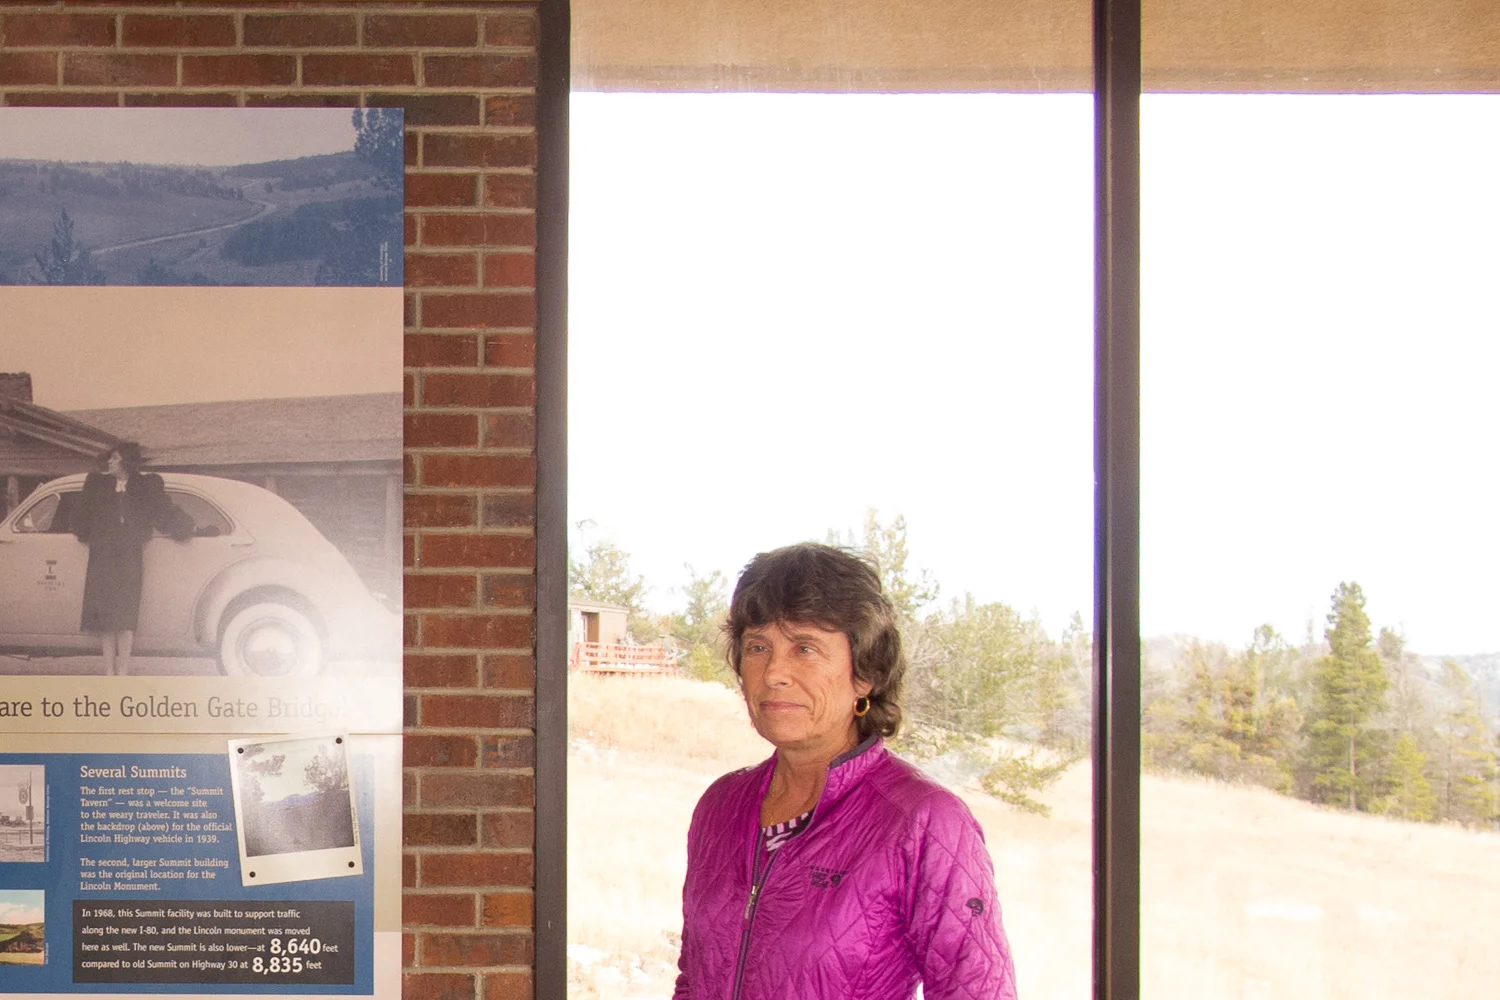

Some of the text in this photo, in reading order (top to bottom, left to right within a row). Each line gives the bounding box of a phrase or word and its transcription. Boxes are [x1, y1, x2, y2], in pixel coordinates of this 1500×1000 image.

[41, 697, 64, 718] to
[73, 695, 111, 718] the
[120, 695, 198, 718] Golden
[208, 696, 258, 718] Gate
[80, 764, 188, 779] Several Summits
[80, 881, 162, 892] Lincoln Monument.
[82, 908, 92, 918] In
[117, 908, 134, 918] this
[134, 908, 166, 918] Summit
[166, 908, 196, 920] facility
[196, 910, 212, 918] was
[213, 908, 233, 919] built
[233, 910, 244, 918] to
[244, 910, 276, 920] support
[276, 908, 301, 919] traffic
[81, 942, 100, 952] here
[100, 944, 111, 952] as
[132, 942, 148, 952] The
[148, 944, 166, 952] new
[166, 942, 198, 952] Summit
[198, 942, 207, 952] is
[207, 942, 225, 952] also
[270, 938, 322, 957] 8,640
[321, 942, 340, 953] feet
[81, 956, 323, 975] compared to old Summit on Highway 30 at 8,835 feet
